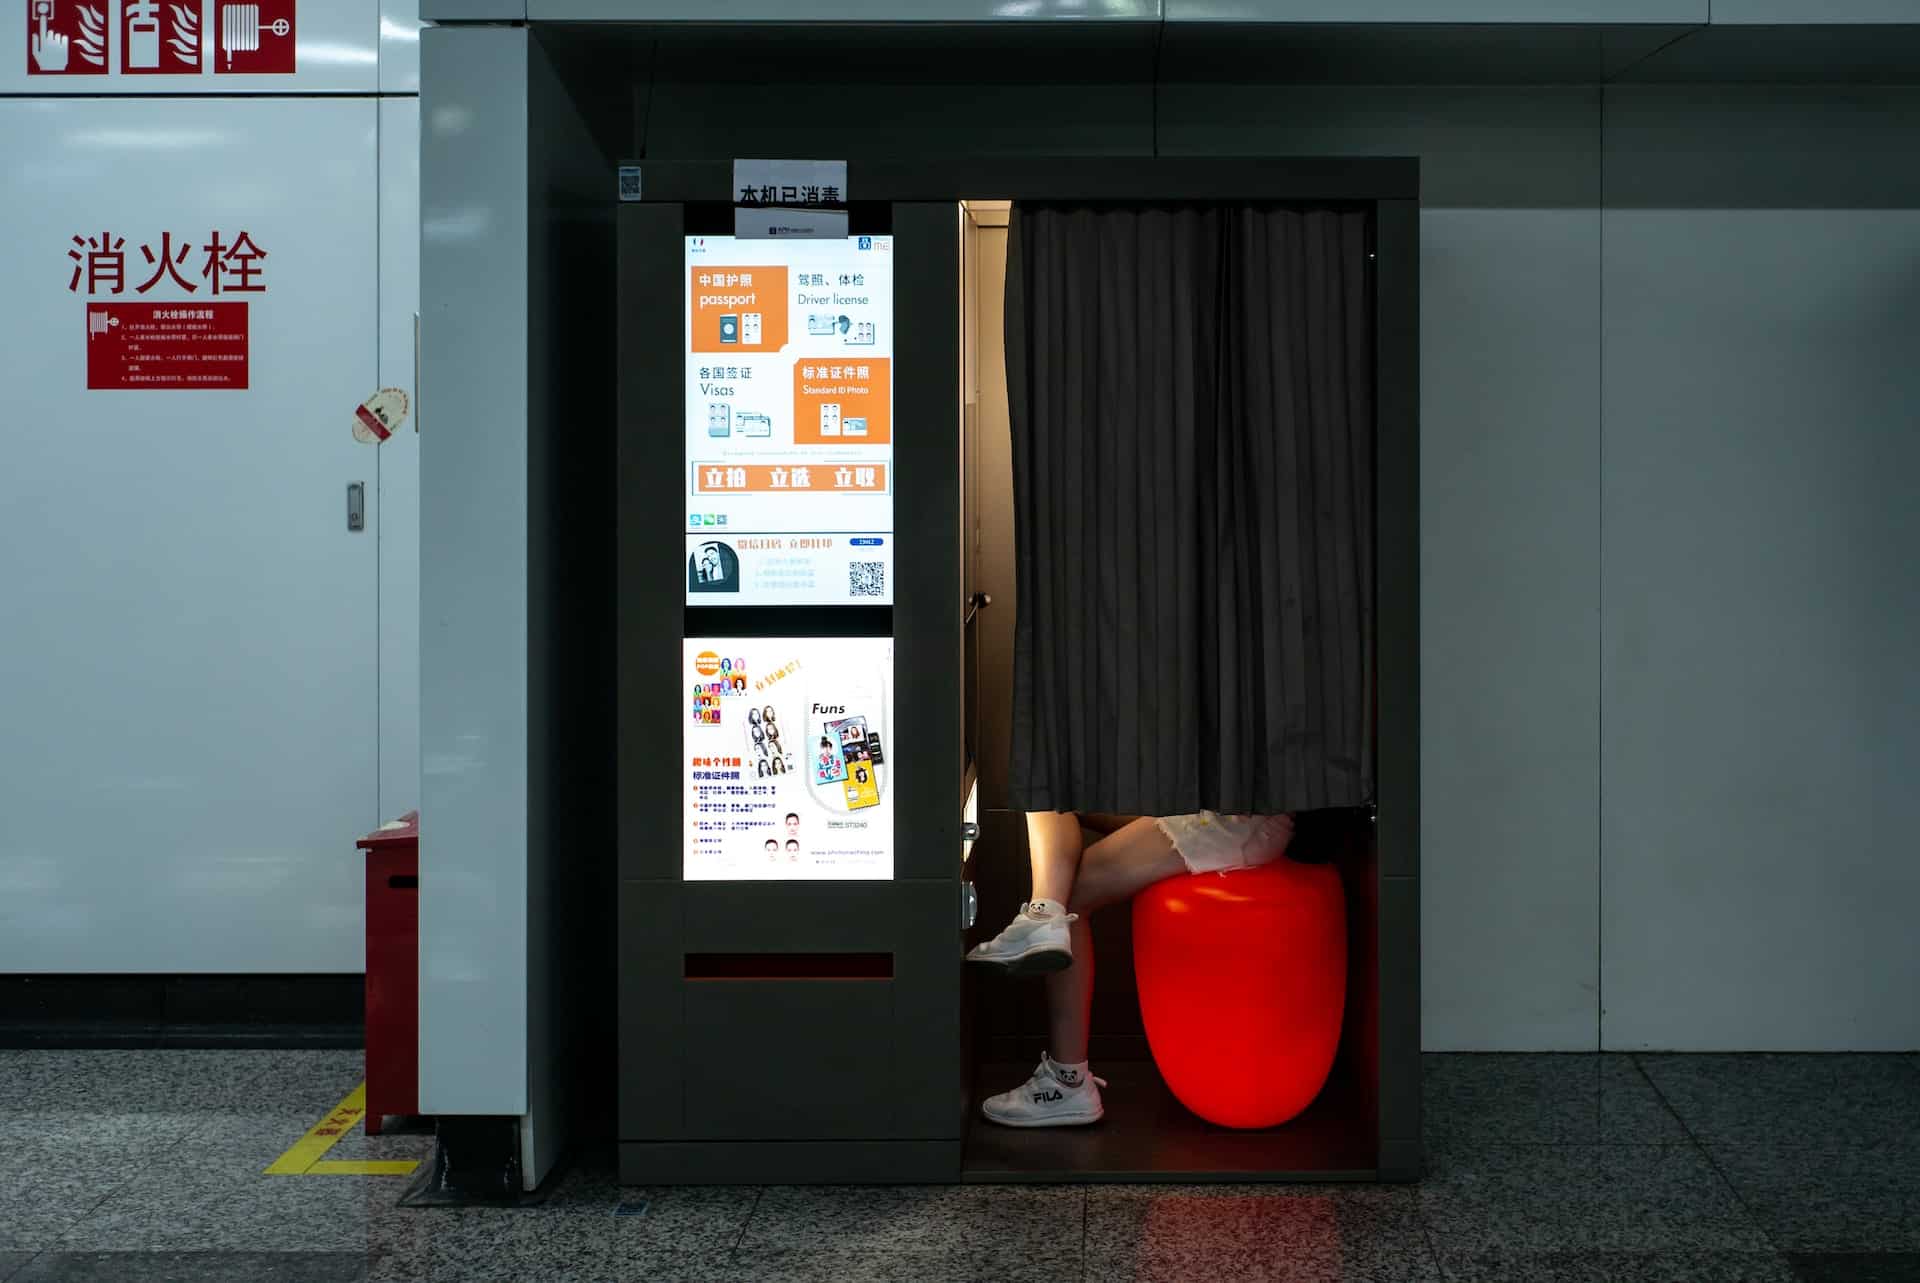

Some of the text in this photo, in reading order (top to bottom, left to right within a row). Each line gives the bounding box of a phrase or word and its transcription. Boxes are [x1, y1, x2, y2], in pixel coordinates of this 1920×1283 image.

[740, 185, 840, 203] 本机已消毒
[68, 231, 267, 294] 消火栓
[699, 273, 753, 287] 中国护照
[798, 273, 865, 287] 驾照、体检
[699, 292, 756, 309] passport
[798, 293, 869, 305] Driver license
[153, 309, 214, 320] 消火栓操作流程
[699, 366, 752, 380] 各国签证
[802, 366, 870, 380] 标准证件照
[700, 383, 735, 396] Visas
[803, 384, 869, 395] Standard ID Photo
[704, 467, 747, 488] 立拍
[832, 467, 876, 488] 立取
[812, 703, 846, 715] Funs
[1033, 1090, 1063, 1104] FILA
